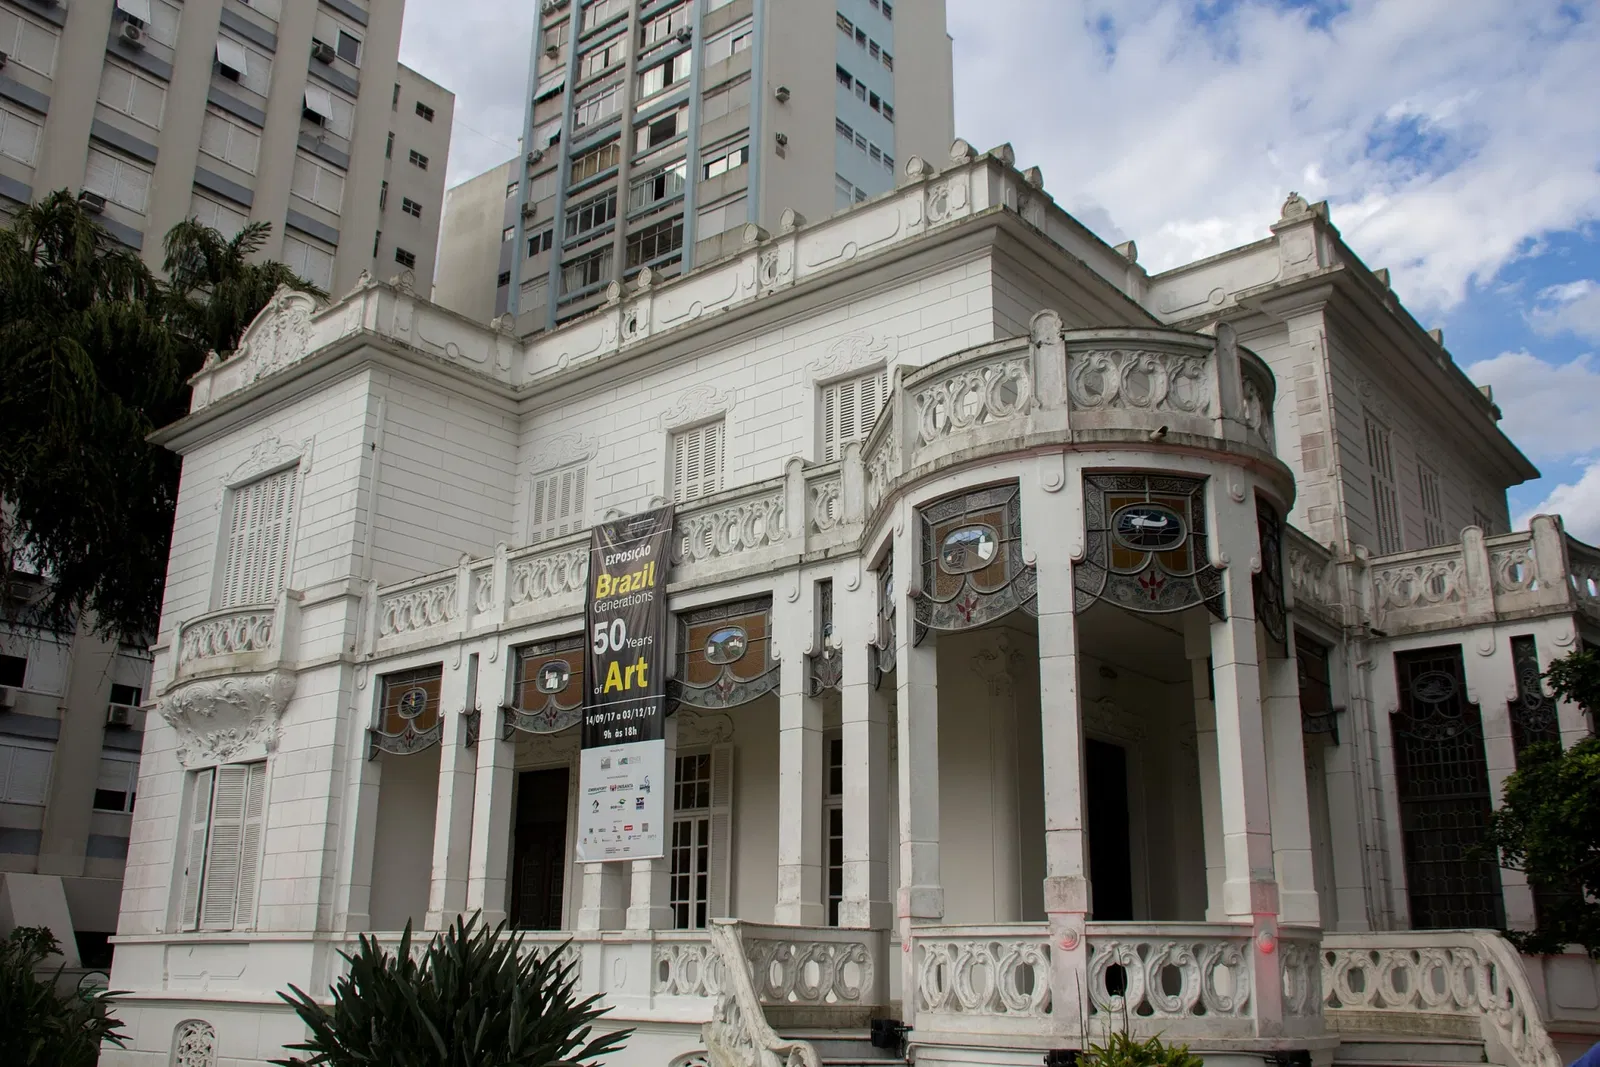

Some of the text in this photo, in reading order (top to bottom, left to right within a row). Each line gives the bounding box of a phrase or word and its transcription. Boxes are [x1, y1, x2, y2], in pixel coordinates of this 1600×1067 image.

[605, 544, 651, 566] EXPOSIÇÃO
[596, 560, 655, 599] Brazil
[594, 591, 653, 613] Generations
[593, 618, 653, 655] 50 Years
[594, 656, 648, 695] of Art
[586, 705, 657, 726] 14/09/17 a 03/12/17
[603, 726, 637, 739] 9h às 18h
